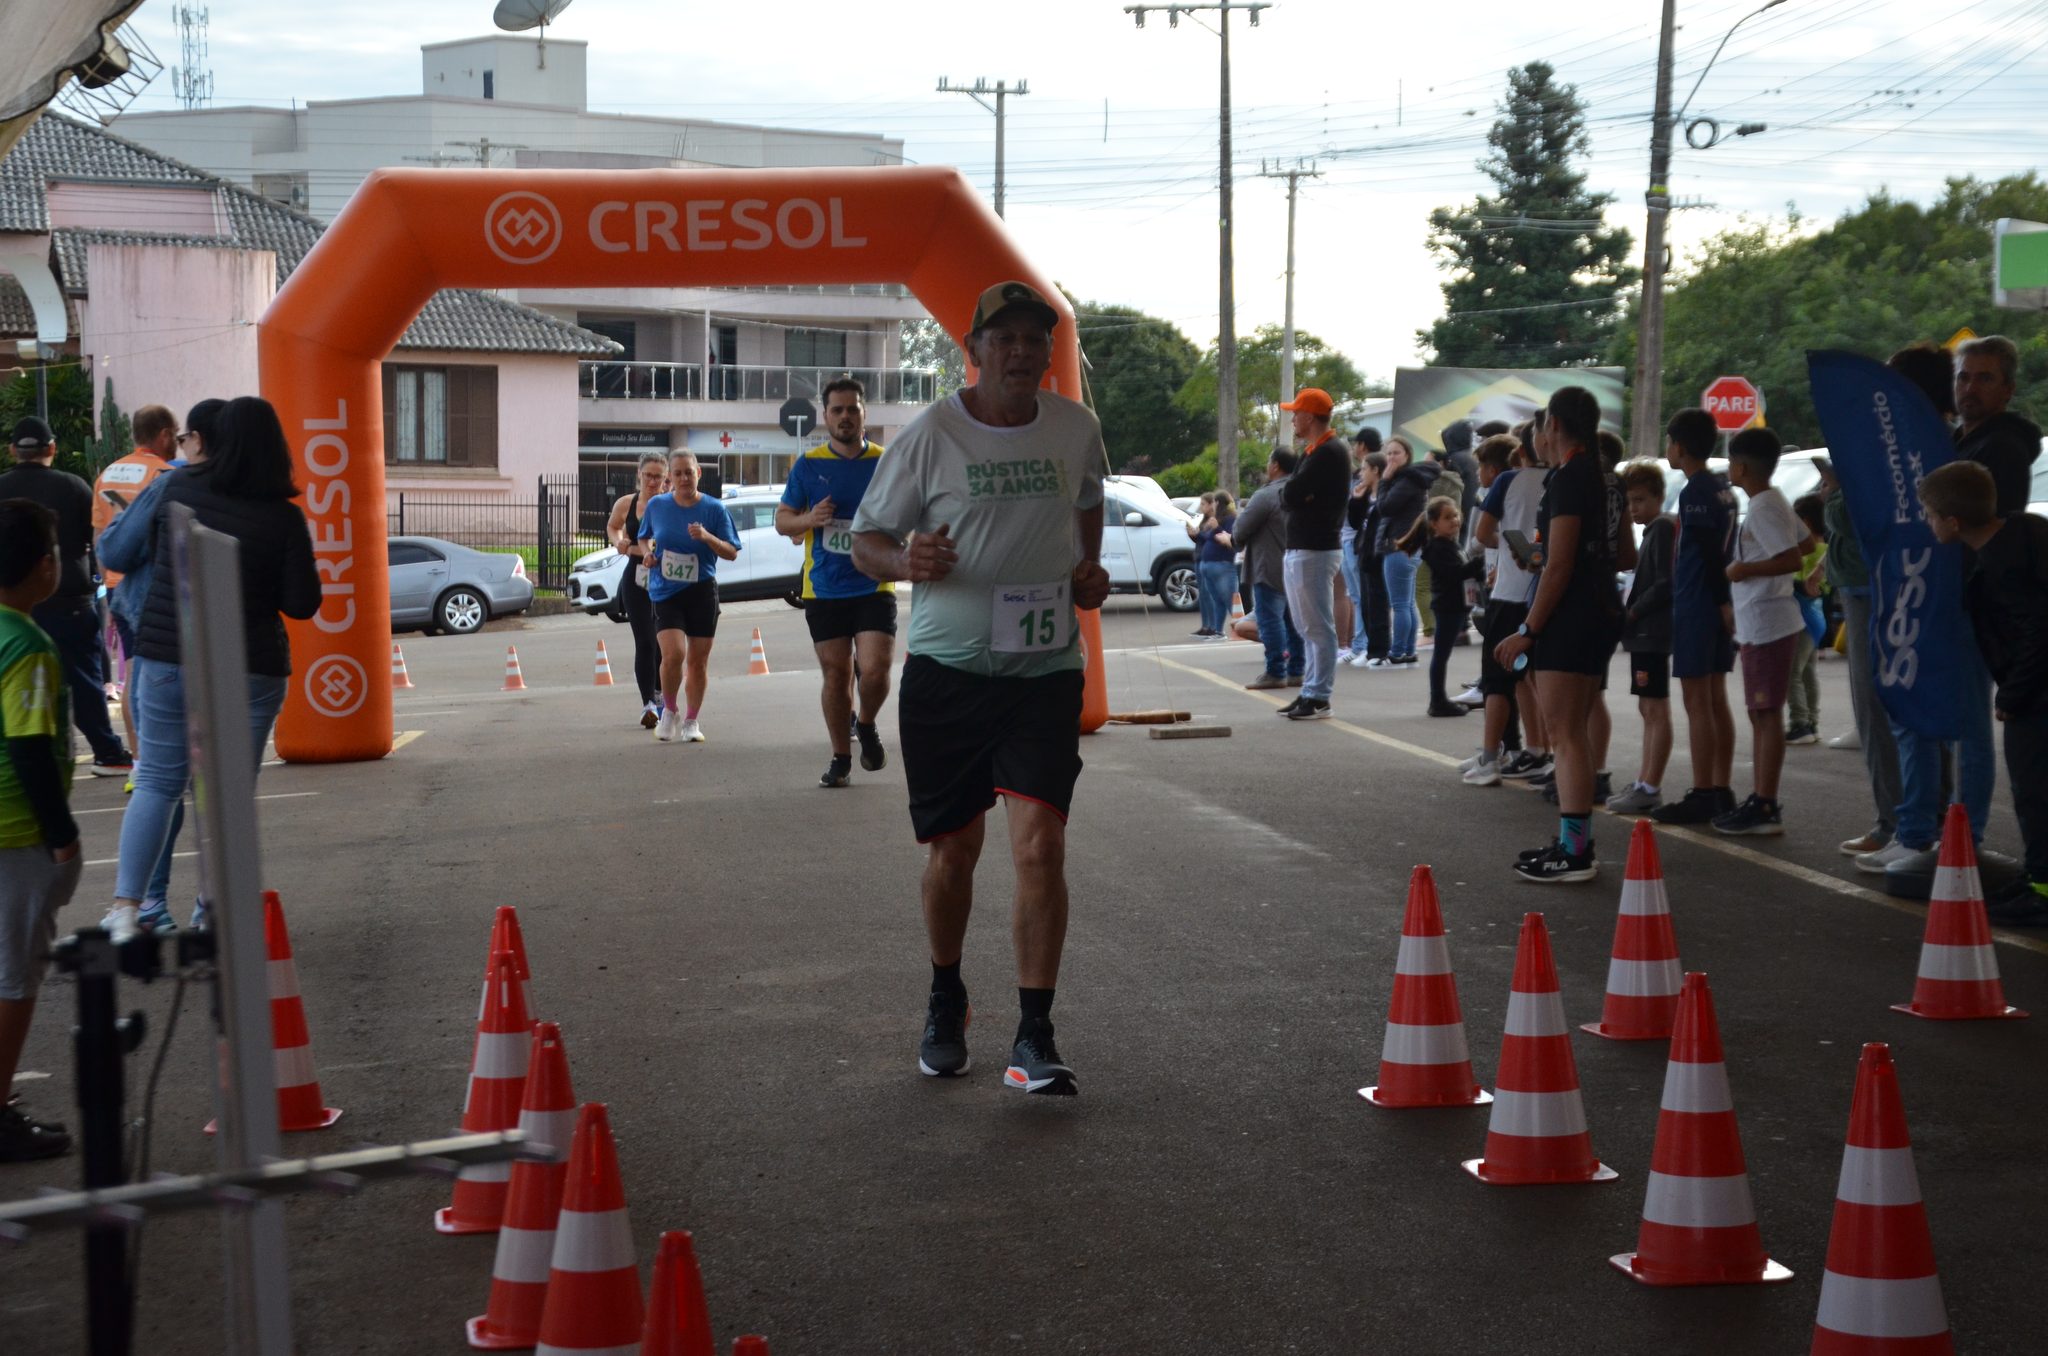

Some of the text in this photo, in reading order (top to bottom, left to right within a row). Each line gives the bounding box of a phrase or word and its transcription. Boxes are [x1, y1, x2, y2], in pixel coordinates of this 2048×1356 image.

[588, 197, 868, 253] CRESOL
[1707, 396, 1754, 412] PARE
[966, 458, 1056, 480] RÚSTICA
[1873, 391, 1911, 524] Fecomércio
[969, 480, 996, 497] 34
[1001, 476, 1060, 495] ANOS
[303, 398, 355, 633] CRESOL
[665, 562, 694, 579] 347
[1019, 608, 1055, 646] 15
[1879, 547, 1931, 690] Sesc
[1543, 860, 1569, 871] FILA
